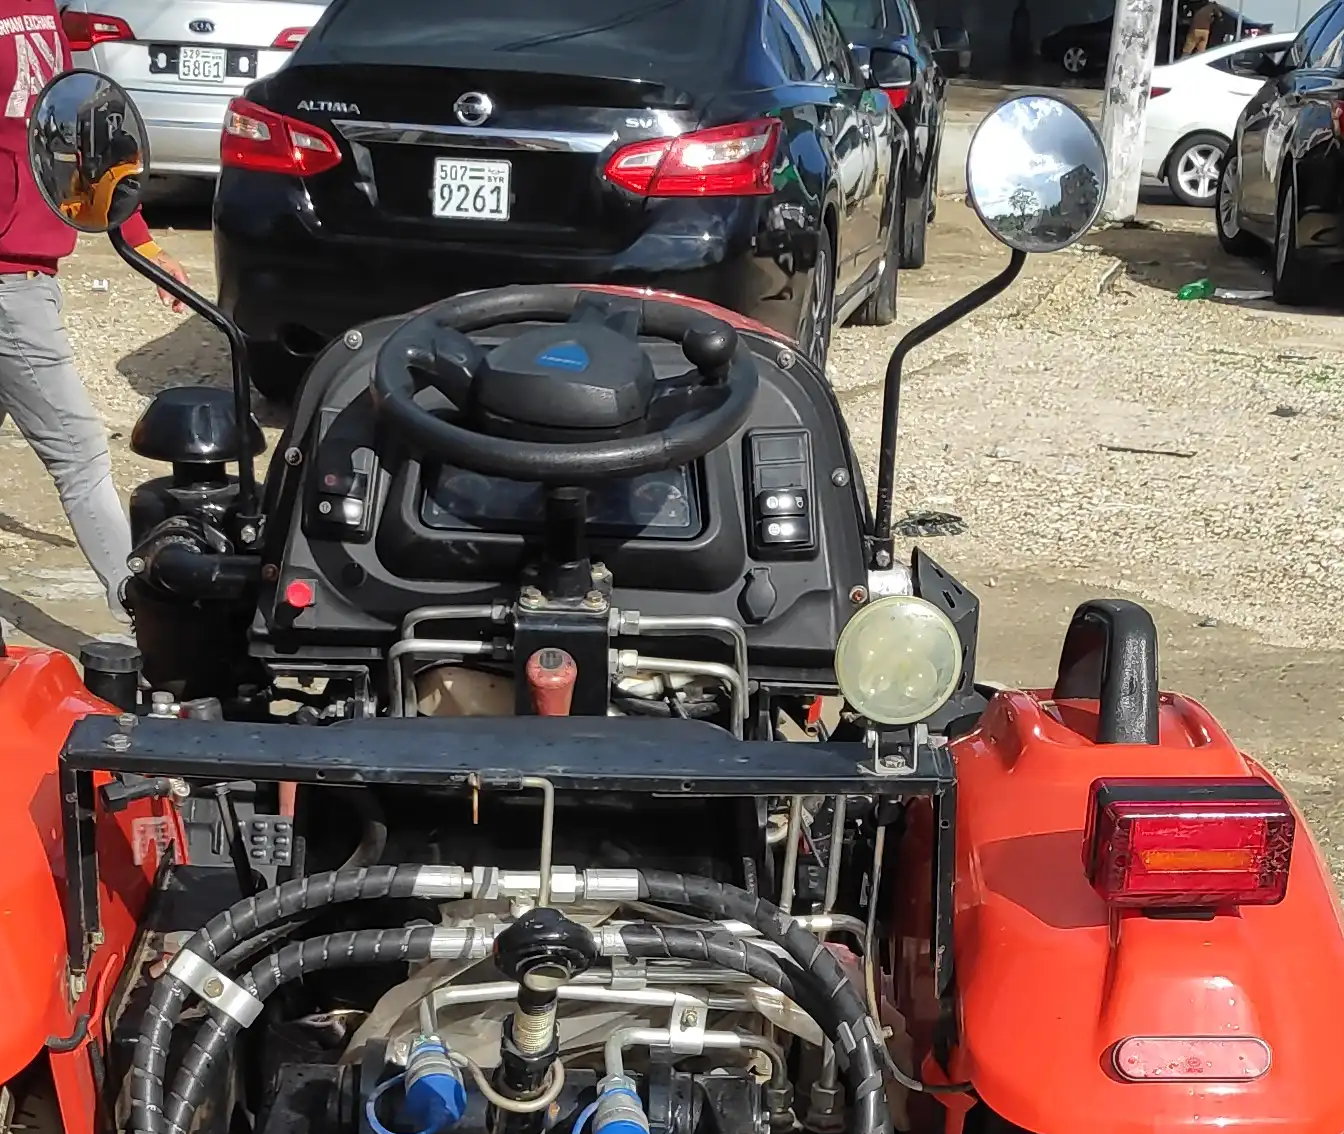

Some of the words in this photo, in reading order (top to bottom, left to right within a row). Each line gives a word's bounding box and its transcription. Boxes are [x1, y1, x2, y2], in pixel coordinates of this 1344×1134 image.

[191, 21, 213, 31] KIA
[182, 60, 222, 78] 5801
[297, 100, 361, 115] ALTIMA
[625, 117, 653, 129] SV
[439, 164, 468, 181] 507
[487, 175, 505, 183] SYR
[439, 183, 503, 214] 9261
